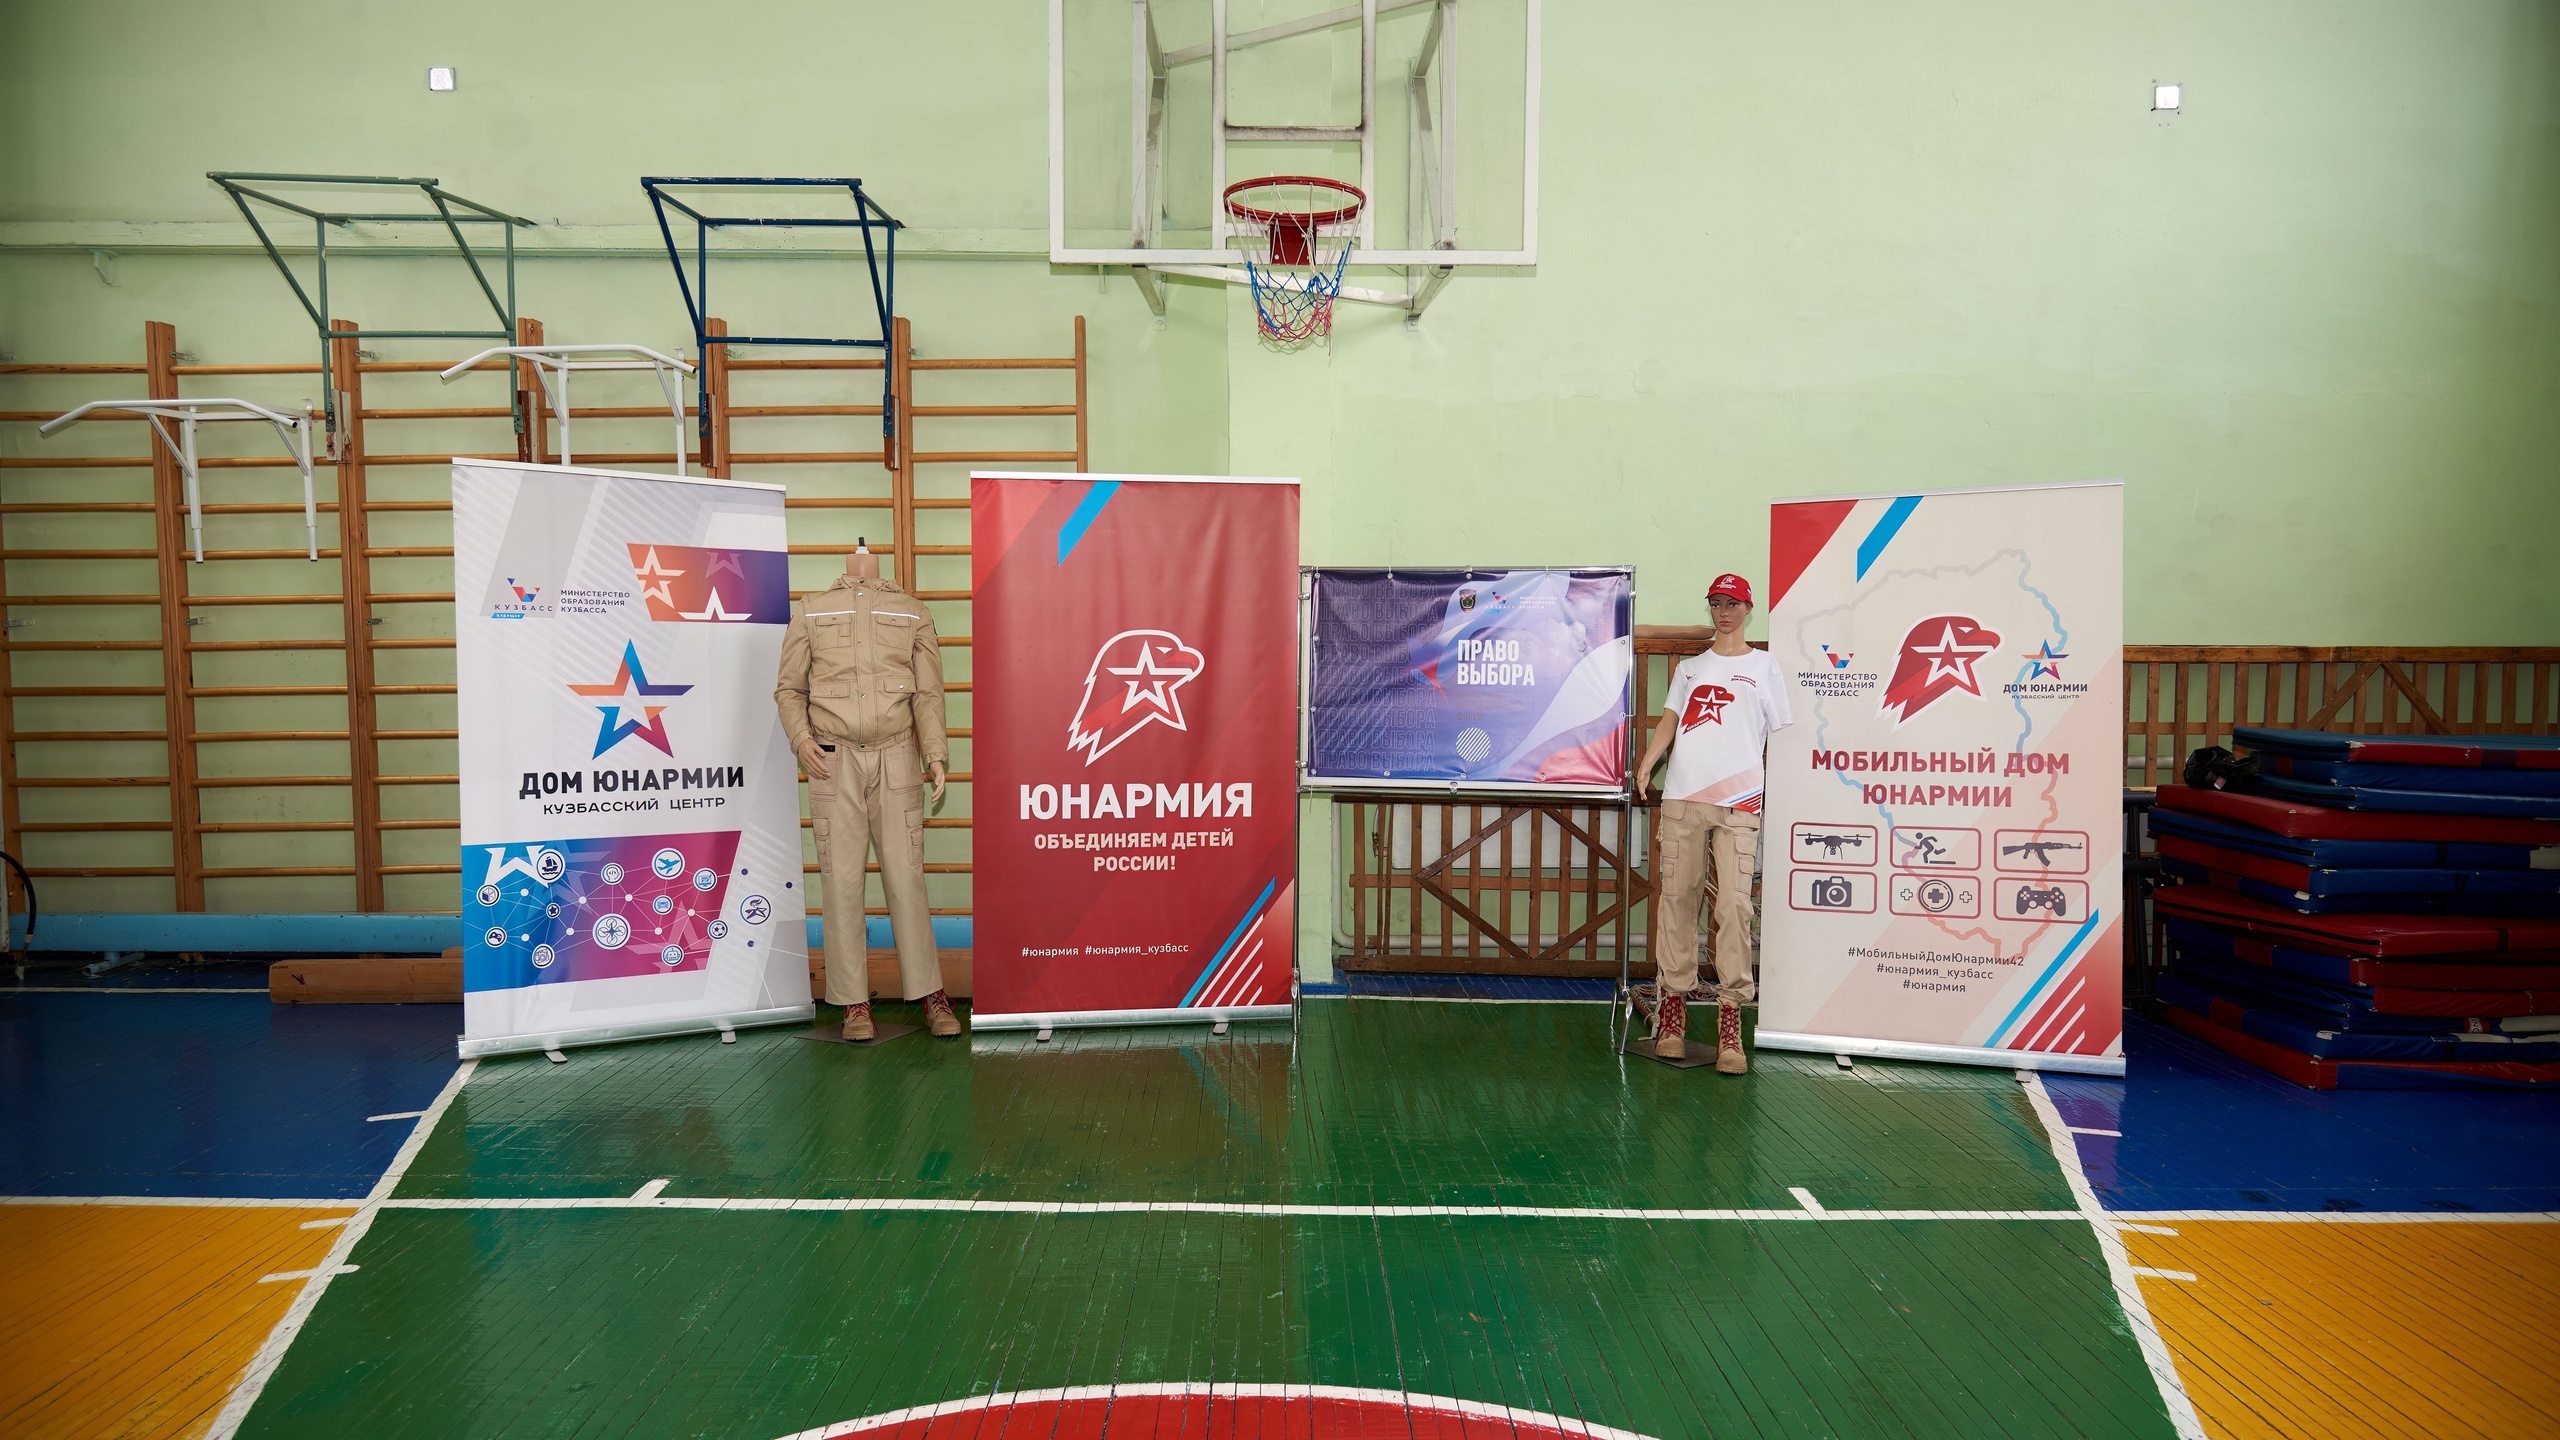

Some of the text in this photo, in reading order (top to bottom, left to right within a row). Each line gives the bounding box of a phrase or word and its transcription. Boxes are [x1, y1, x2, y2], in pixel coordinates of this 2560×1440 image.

[560, 589, 631, 598] МИНИСТЕРСТВО
[1320, 581, 1439, 599] ПРАВО ВЫБОРА
[494, 604, 553, 612] КУЗБАСС
[560, 598, 625, 606] ОБРАЗОВАНИЯ
[560, 606, 607, 614] КУЗБАССА
[1320, 601, 1439, 621] ПРАВО ВЫБОРА
[1319, 622, 1370, 641] ПРАВО
[1457, 639, 1520, 662] ПРАВО
[1457, 663, 1536, 686] ВЫБОРА
[1797, 672, 1878, 681] МИНИСТЕРСТВО
[1800, 680, 1875, 689] ОБРАЗОВАНИЯ
[2003, 683, 2088, 694] ДОМ ЮНАРМИИ
[1372, 687, 1437, 708] ВЫБОРА
[1371, 709, 1436, 728] ВЫБОРА
[1371, 730, 1436, 750] ВЫБОРА
[1317, 750, 1436, 771] ПРАВО ВЫБОРА
[1812, 747, 2070, 778] МОБИЛЬНЫЙ ДОМ
[519, 766, 744, 799] ДОМ ЮНАРМИИ
[1019, 782, 1253, 820] ЮНАРМИЯ
[1862, 783, 2012, 808] ЮНАРМИИ
[543, 797, 726, 815] КУЗБАССКИЙ ЦЕНТР
[1034, 828, 1234, 851] ОБЪЕДИНЯЕМ ДЕТЕЙ
[1093, 855, 1176, 872] РОССИИ!
[1021, 943, 1189, 957] #юнармия #юнармия_кузбасс
[1847, 946, 2024, 967] #МобильныйДомЮнармии42
[1876, 963, 1994, 980] #юнармия_кузбасс
[1902, 979, 1966, 993] #юнармия
